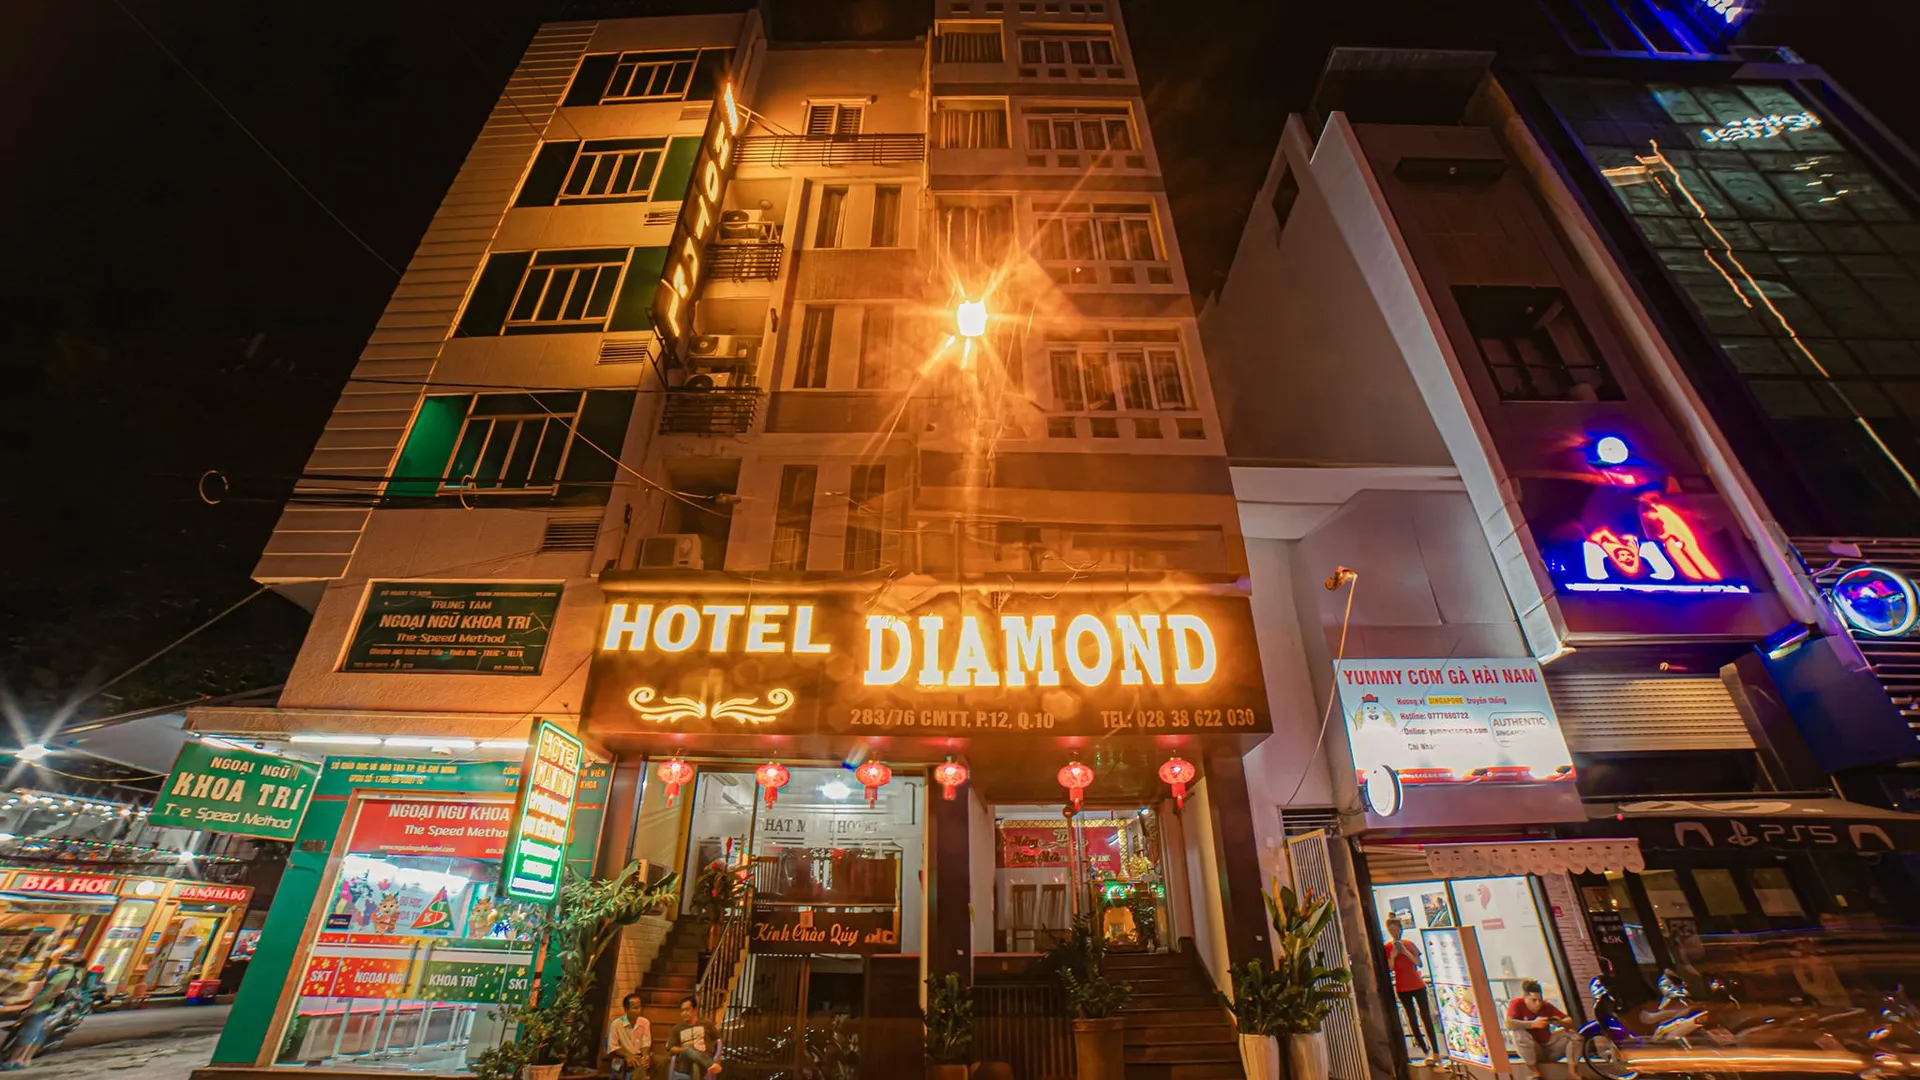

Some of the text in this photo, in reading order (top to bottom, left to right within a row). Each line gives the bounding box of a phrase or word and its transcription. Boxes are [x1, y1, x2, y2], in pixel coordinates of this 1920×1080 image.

[379, 615, 425, 630] NGOẠI
[460, 615, 502, 628] KHOA
[397, 633, 506, 644] The Speed Method
[603, 603, 1217, 687] HOTEL DIAMOND
[1343, 670, 1402, 685] YUMMY
[1407, 668, 1444, 685] CƠM
[1447, 666, 1469, 684] GÀ
[1501, 668, 1538, 683] NAM
[851, 708, 1054, 729] 283/76 CMTT, P.12, Q.10
[1137, 710, 1165, 728] 028
[1171, 710, 1190, 727] 38
[1194, 709, 1223, 727] 622
[1227, 708, 1255, 726] 030
[1493, 717, 1546, 727] AUTHENTIC
[210, 756, 256, 775] NGOẠI
[171, 771, 307, 810] KHOA TRÍ
[164, 803, 293, 829] Te Speed Method
[389, 804, 435, 820] NGOẠI
[469, 806, 509, 821] KHOA
[405, 824, 424, 834] The
[428, 825, 464, 836] Speed
[1759, 824, 1838, 844] PS5
[21, 875, 65, 891] BIA
[310, 970, 332, 982] SKT
[354, 970, 387, 984] NGOẠI
[429, 974, 457, 987] KHOA
[461, 974, 478, 987] TRÍ
